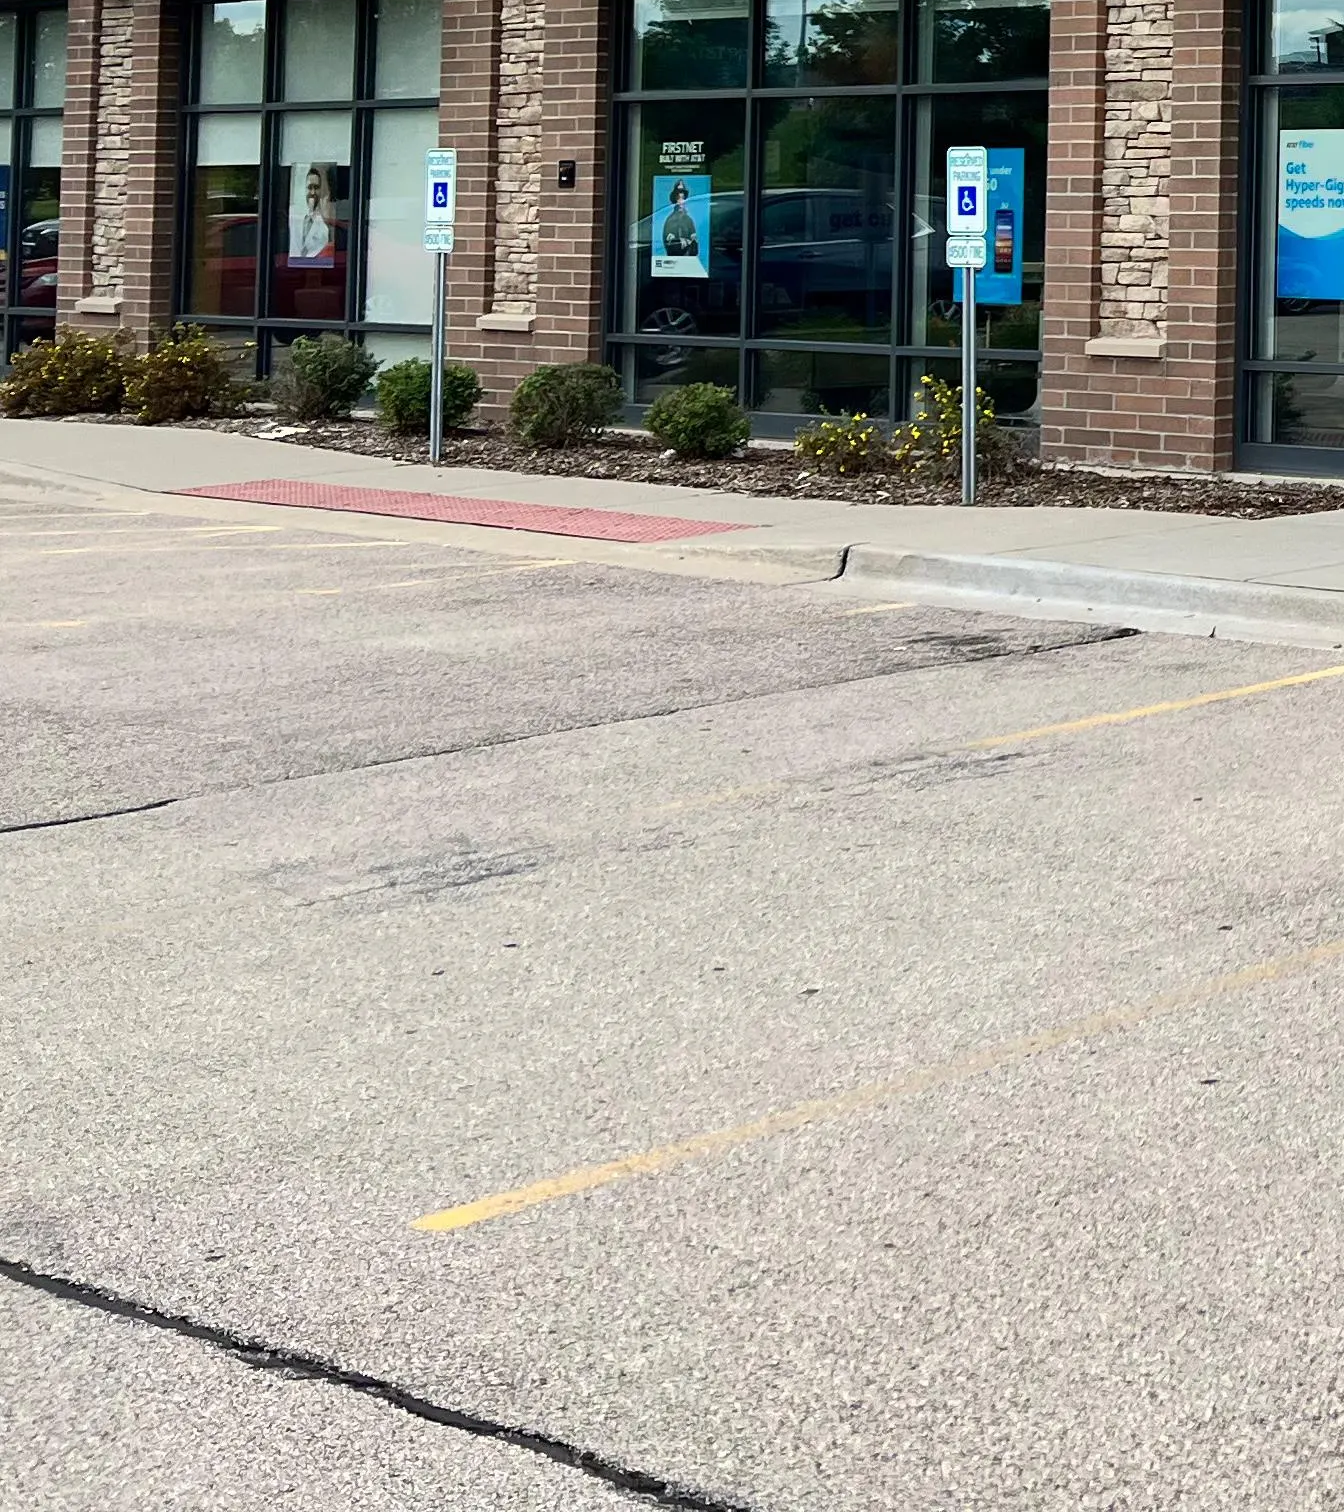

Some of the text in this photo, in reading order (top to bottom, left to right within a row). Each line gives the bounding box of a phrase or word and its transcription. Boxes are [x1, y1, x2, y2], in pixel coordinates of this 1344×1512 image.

[662, 141, 704, 153] FIRSTNET
[1286, 161, 1307, 174] Get
[953, 170, 981, 181] PARKING
[1286, 178, 1344, 194] Hyper-Gig
[1285, 194, 1325, 211] speeds
